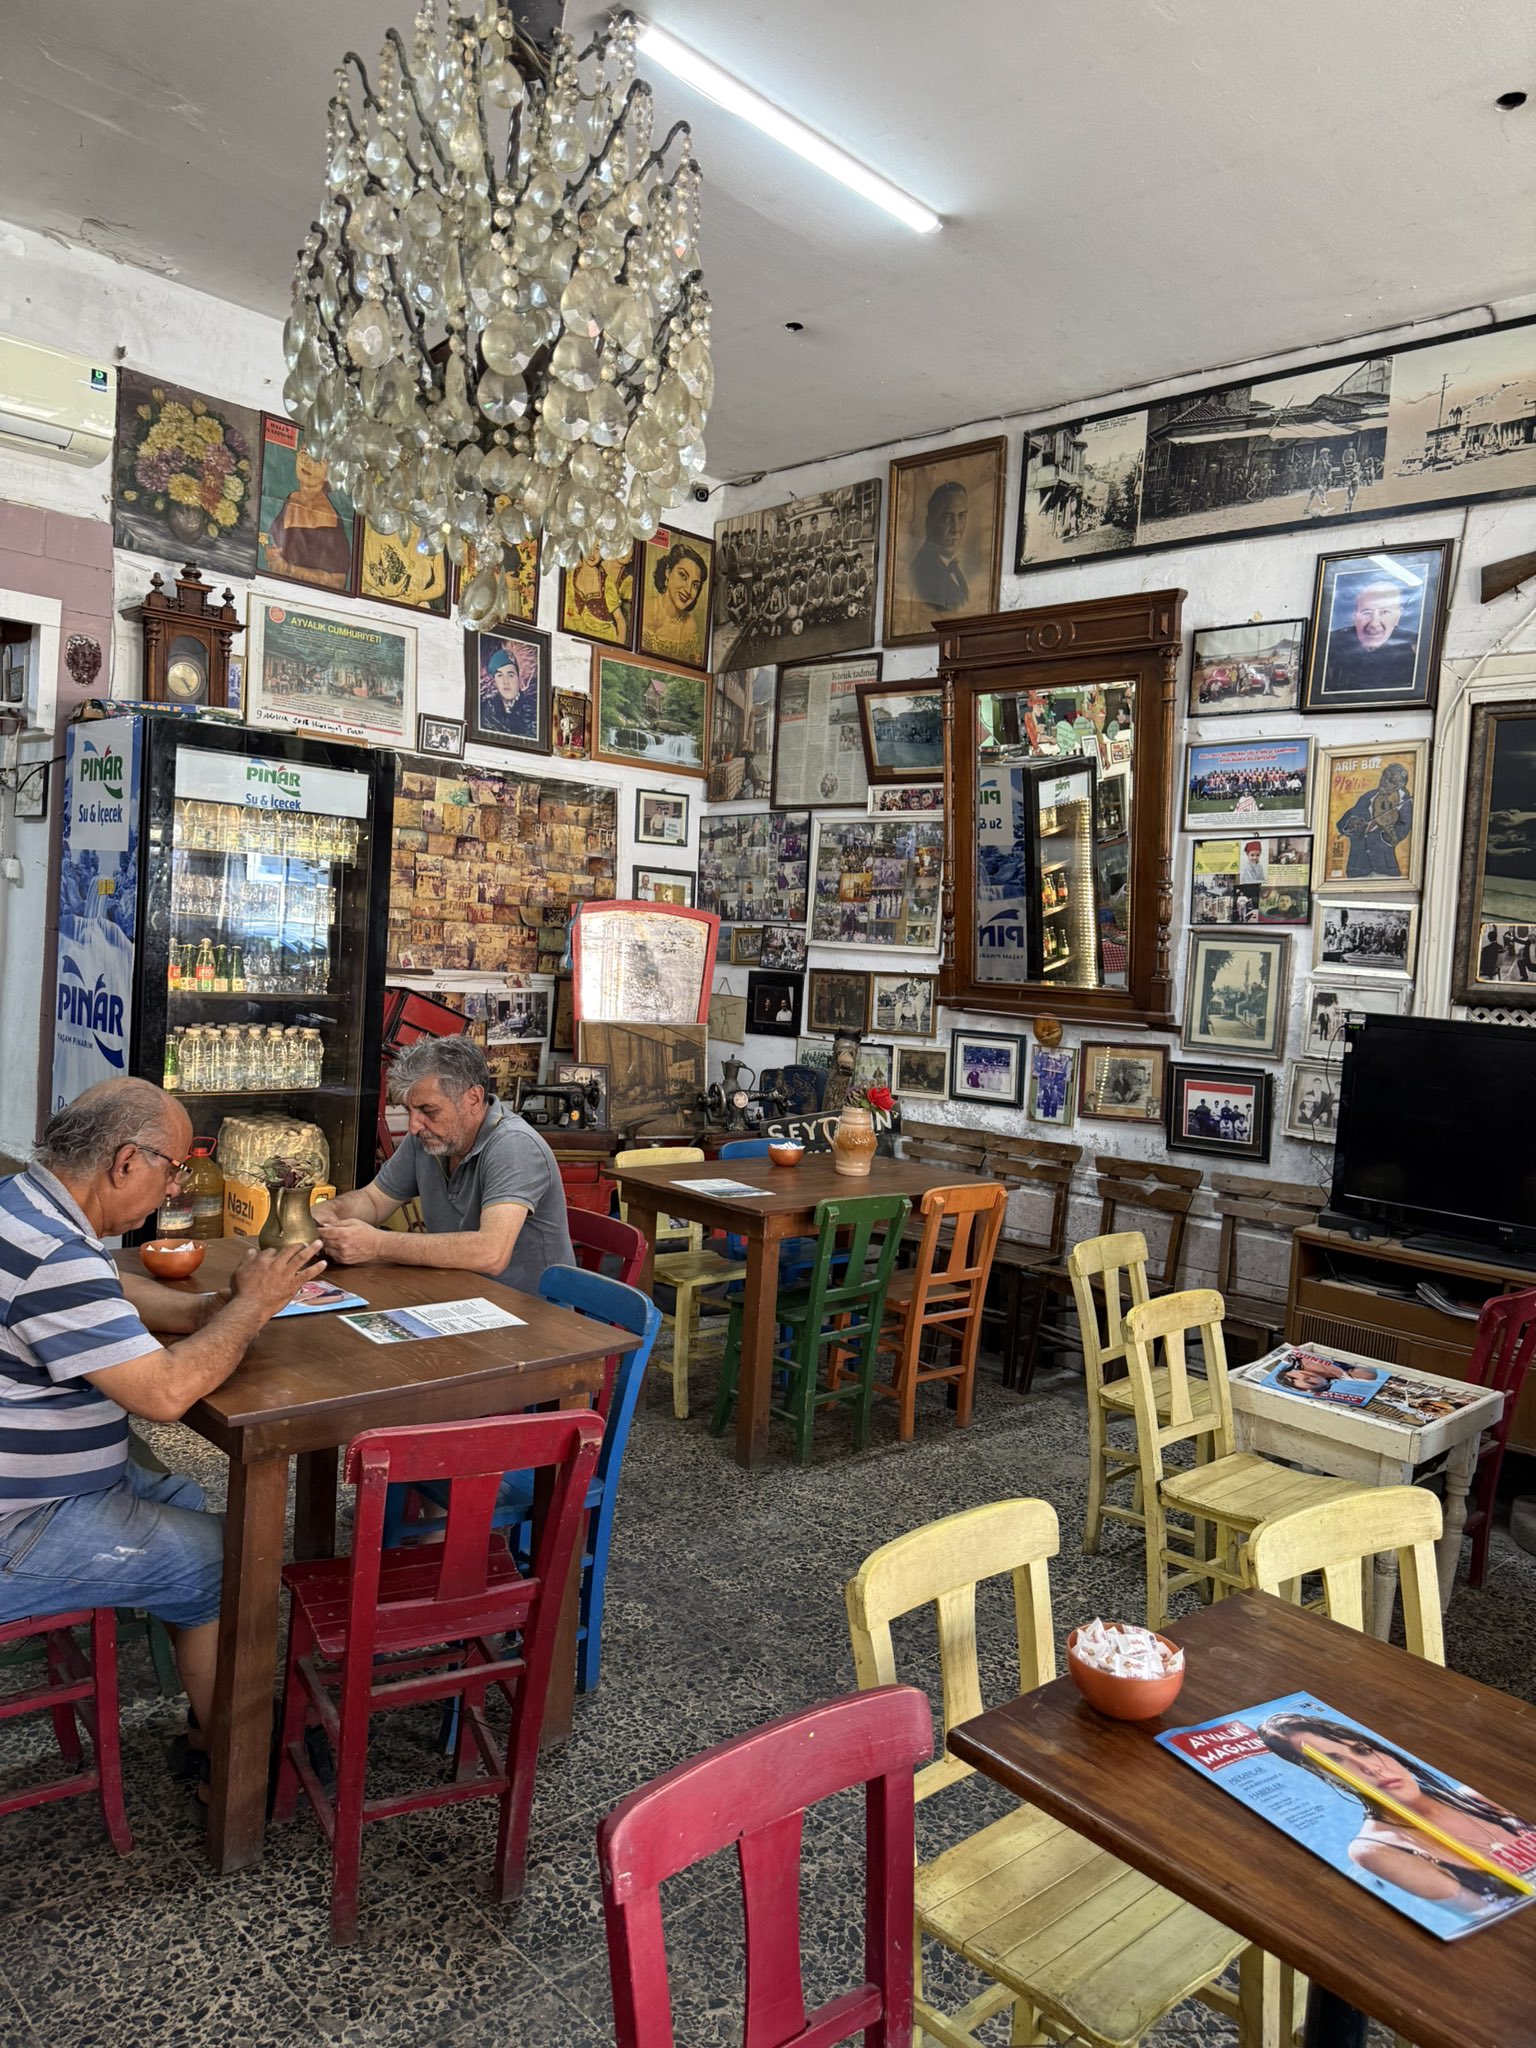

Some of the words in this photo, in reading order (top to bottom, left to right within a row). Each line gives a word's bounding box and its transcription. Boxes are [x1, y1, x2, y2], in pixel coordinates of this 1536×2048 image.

[291, 617, 326, 631] AYVALIK
[1335, 760, 1358, 772] ARİF
[245, 793, 258, 805] Su
[260, 795, 268, 806] &
[79, 804, 88, 822] Su
[90, 804, 96, 822] &
[97, 801, 123, 826] İçecek
[227, 1191, 254, 1221] Nazlı
[1188, 1726, 1249, 1750] AYVALIK
